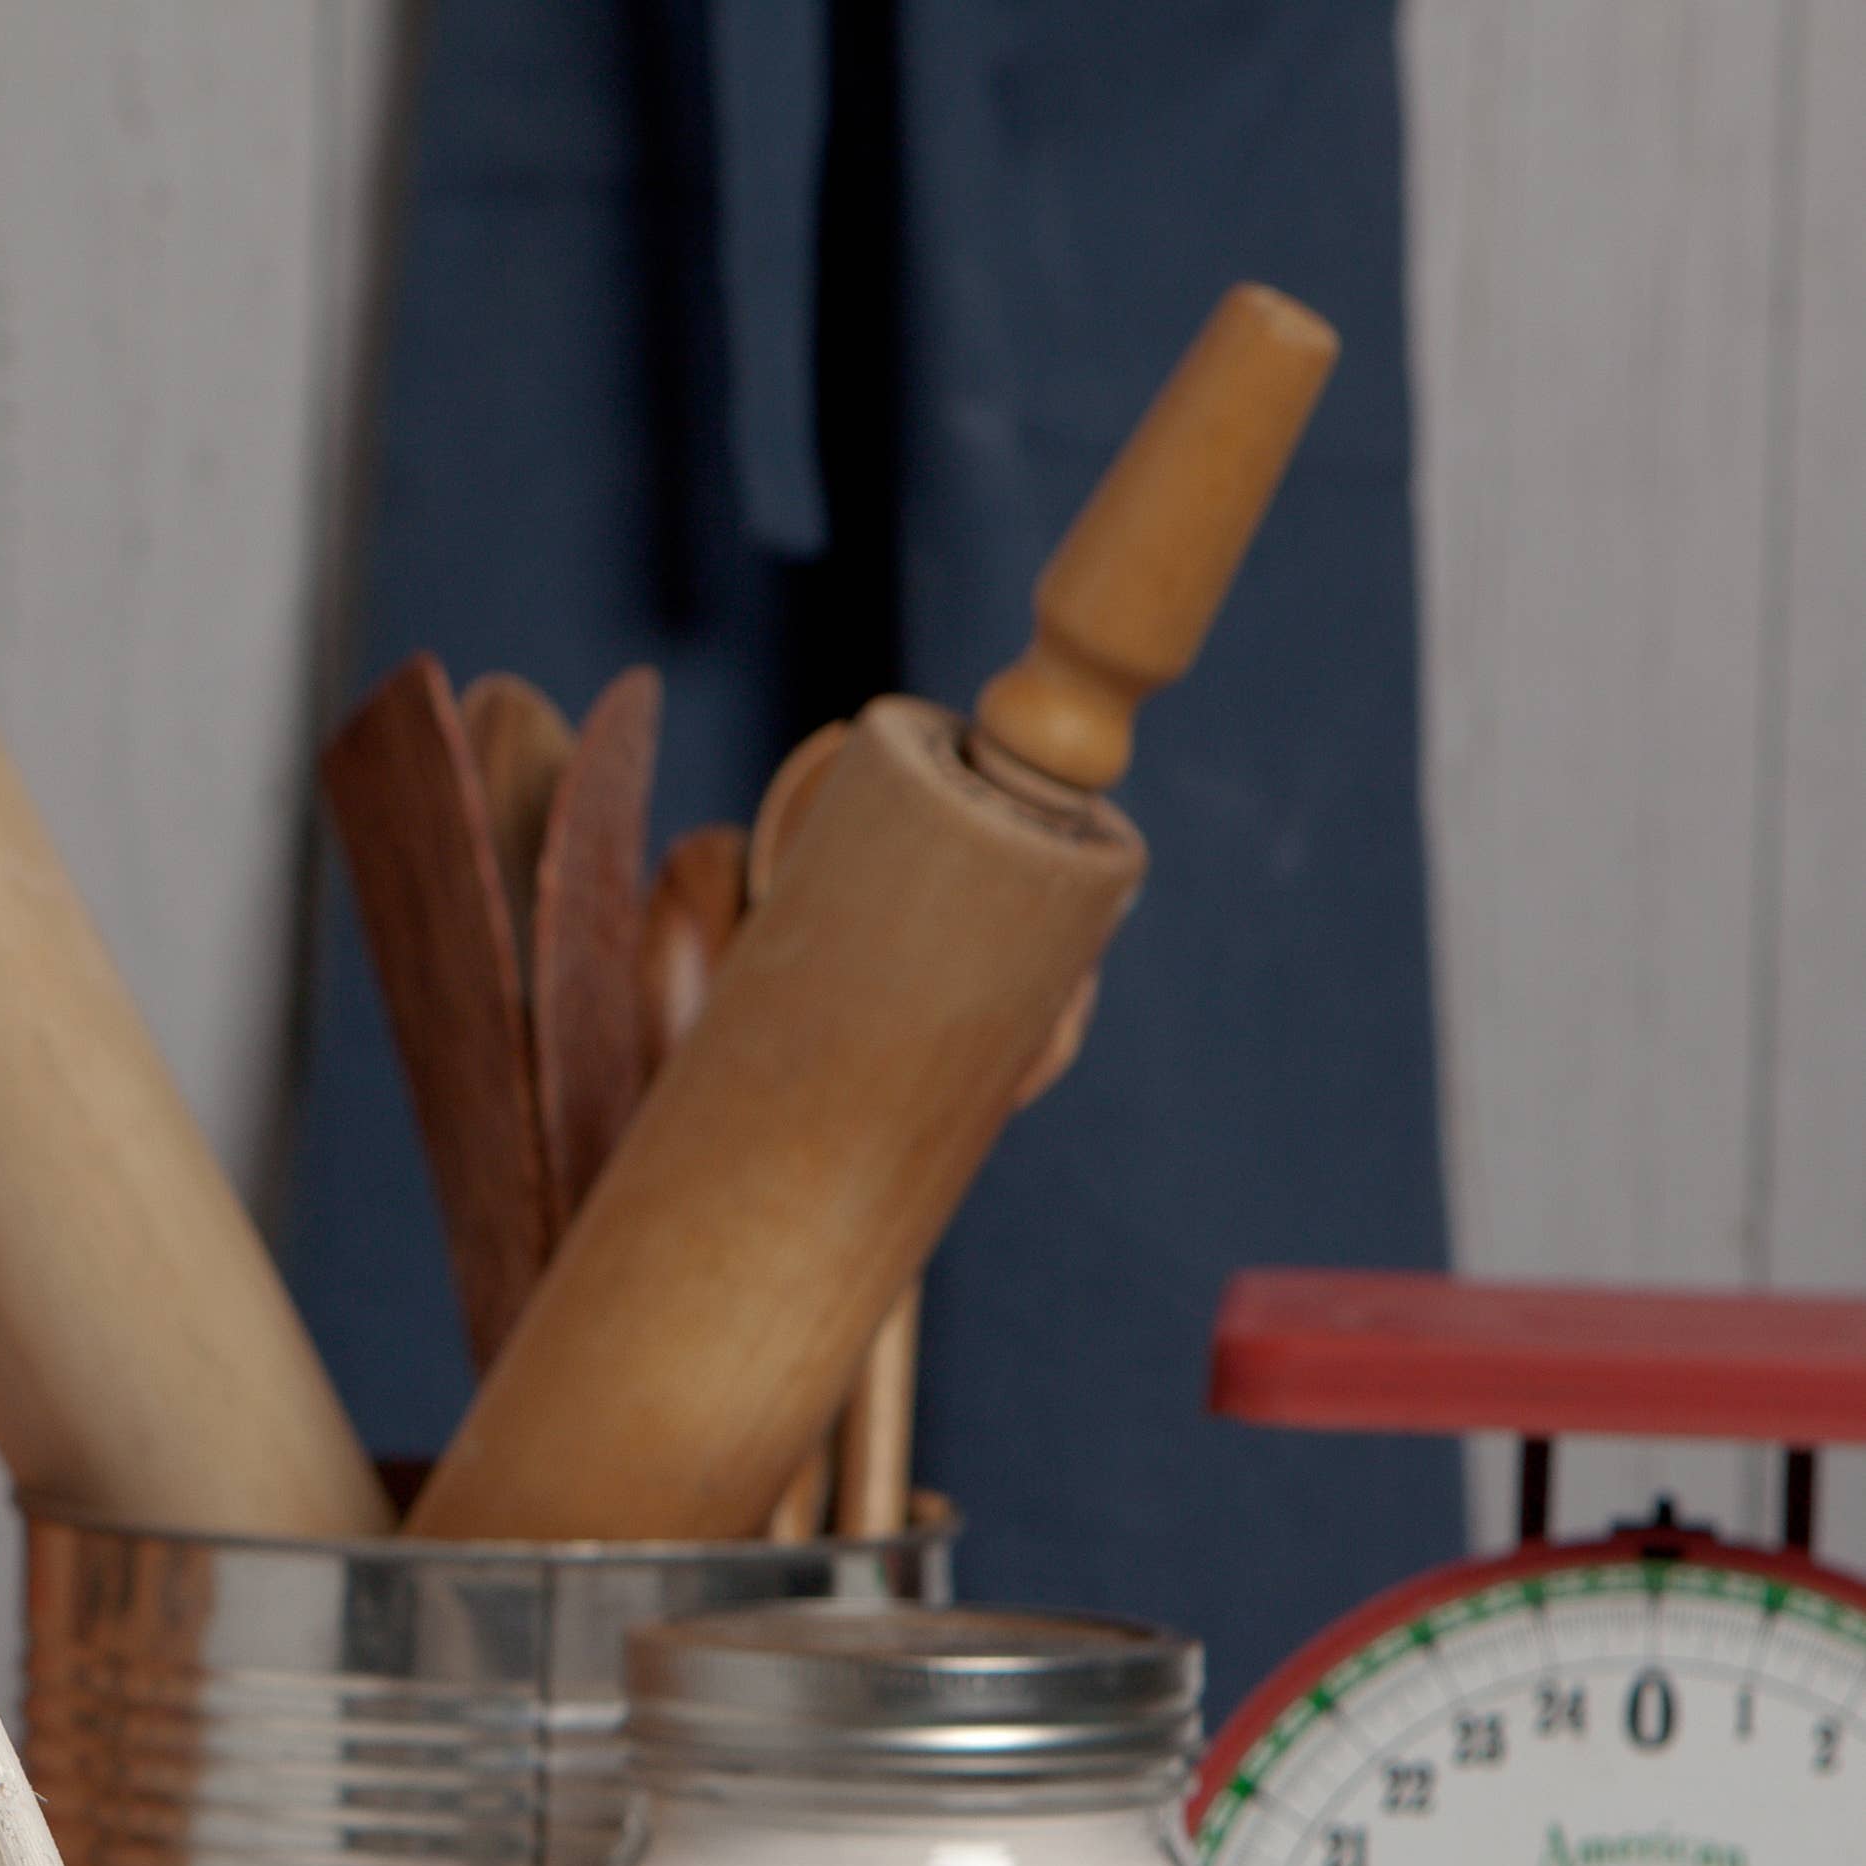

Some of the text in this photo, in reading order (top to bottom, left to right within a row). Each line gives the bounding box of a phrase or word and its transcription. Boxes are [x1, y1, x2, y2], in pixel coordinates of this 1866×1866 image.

[1536, 1678, 1587, 1737] 24
[1624, 1668, 1677, 1750] 0
[1736, 1685, 1755, 1740] 1
[1453, 1710, 1506, 1767] 23
[1814, 1714, 1844, 1776] 2
[1384, 1759, 1436, 1814] 22
